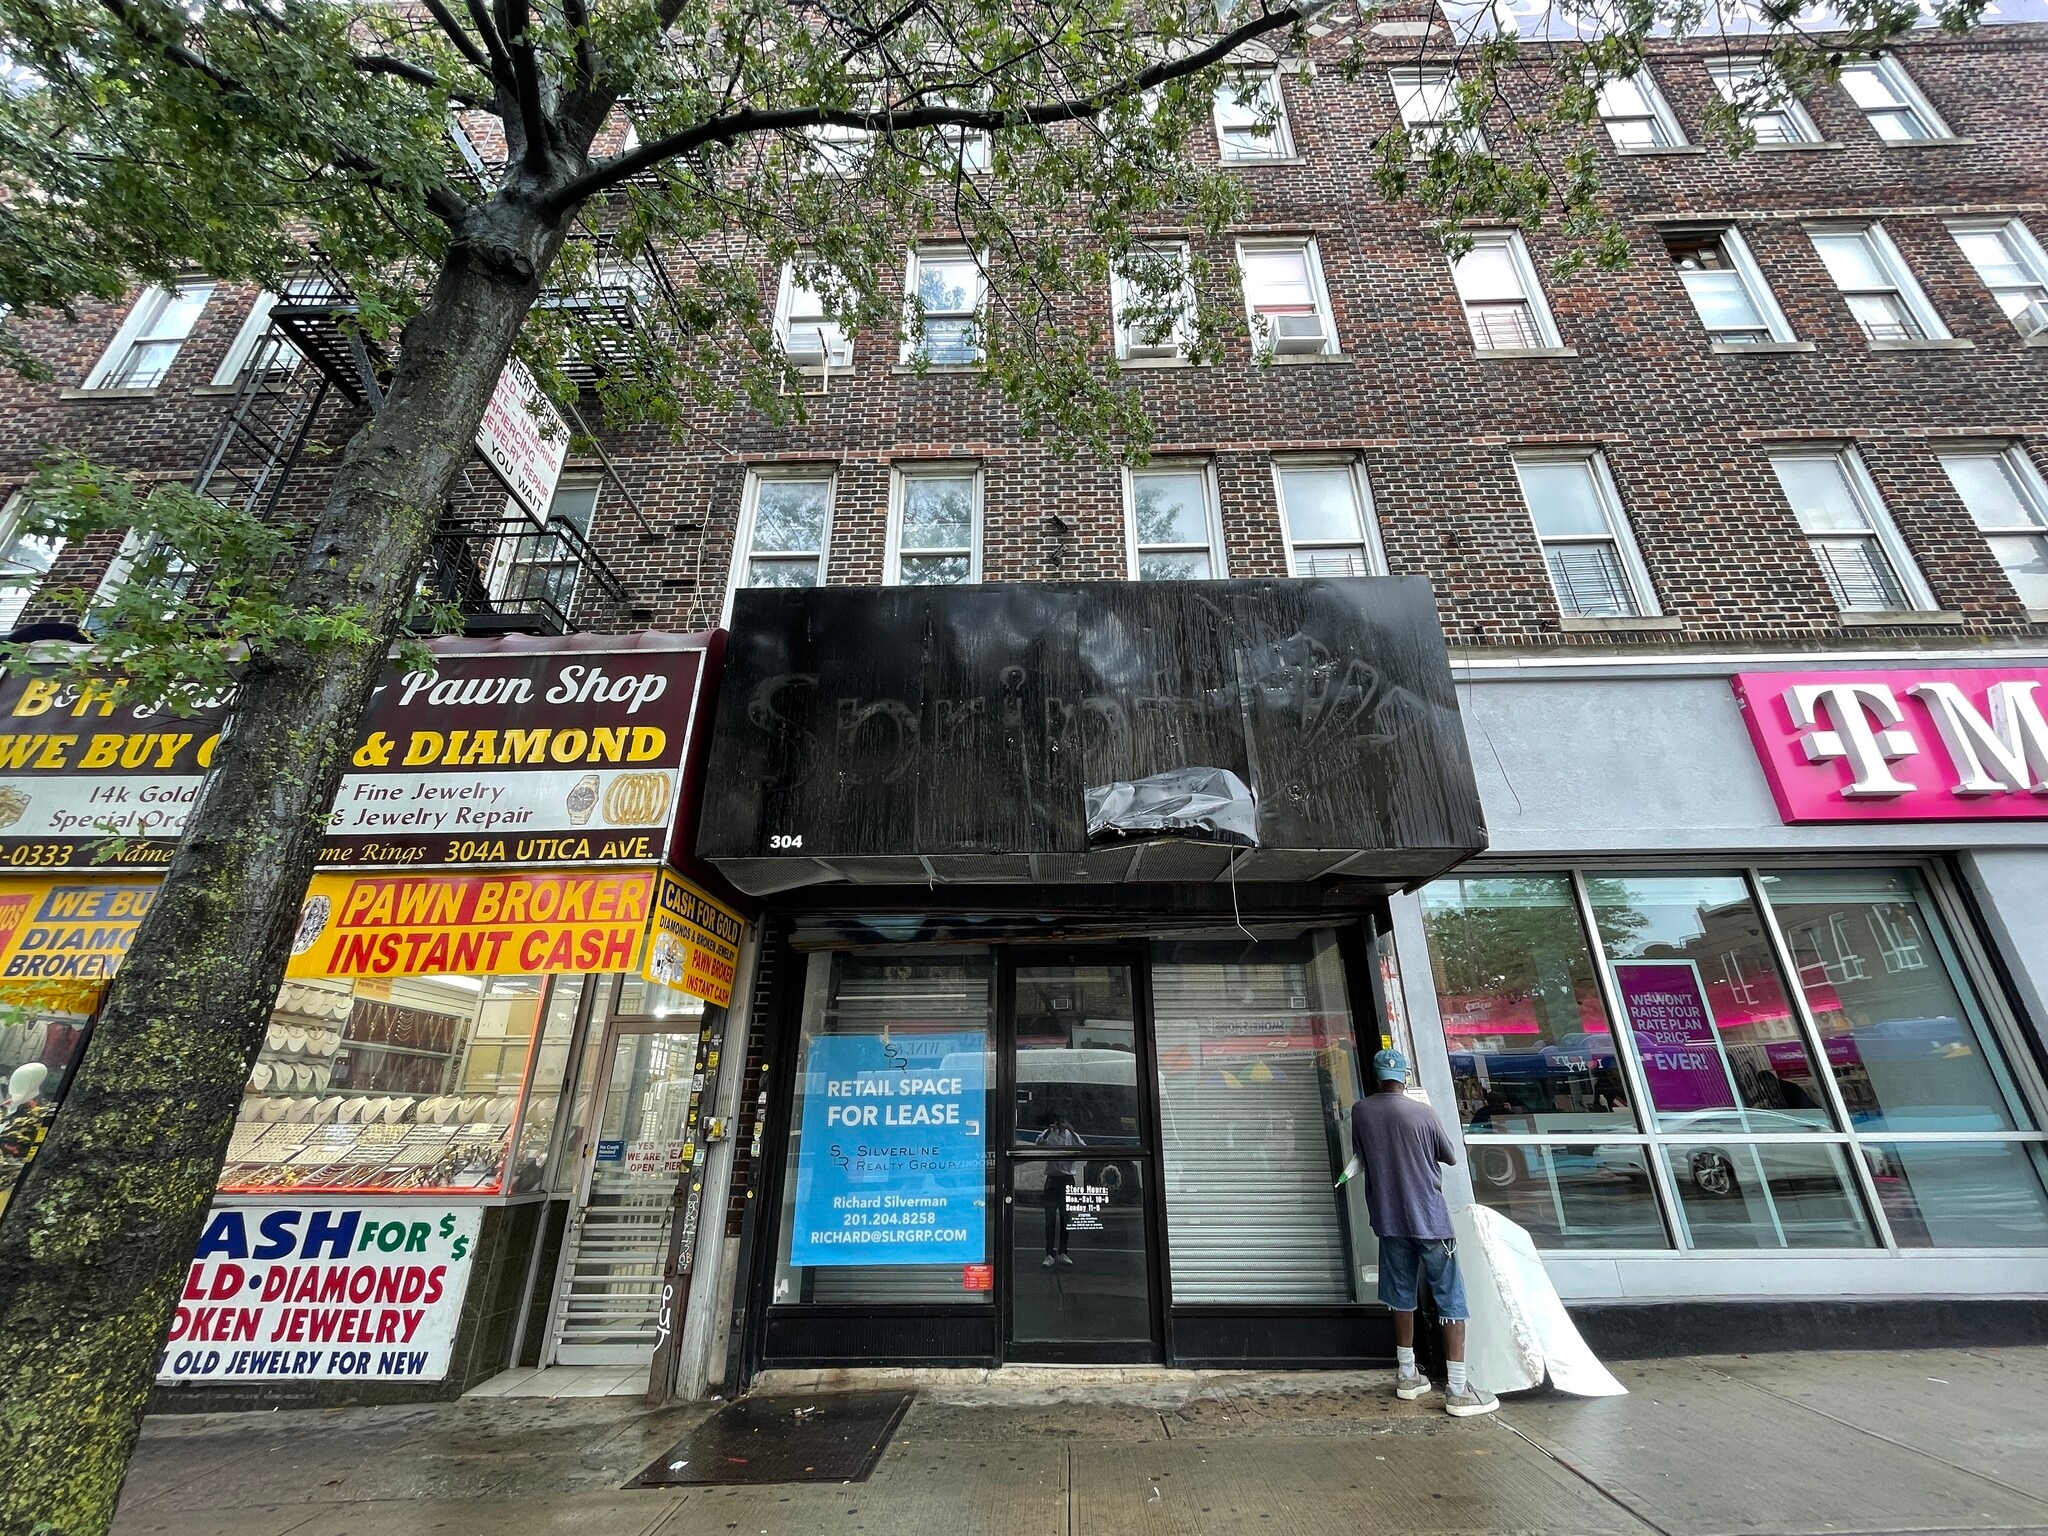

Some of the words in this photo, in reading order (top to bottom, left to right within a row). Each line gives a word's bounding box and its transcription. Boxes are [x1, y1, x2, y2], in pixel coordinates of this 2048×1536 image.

[482, 410, 522, 465] JEWELRY
[521, 460, 550, 502] REPAIR
[518, 416, 558, 474] NAMERING
[489, 440, 515, 477] YOU
[516, 474, 545, 515] WAIT
[398, 668, 535, 707] Pawn
[545, 664, 668, 714] Shop
[0, 733, 79, 769] WE
[77, 733, 194, 769] BUY
[352, 731, 396, 767] &
[401, 726, 667, 767] DIAMOND
[89, 786, 132, 804] 14k
[139, 785, 200, 804] Gold
[353, 783, 404, 801] Fine
[410, 782, 506, 804] Jewelry
[48, 809, 137, 833] Special
[330, 808, 346, 826] &
[352, 807, 449, 830] Jewelry
[455, 806, 534, 830] Repair
[0, 844, 74, 866] -0333
[359, 842, 428, 865] Rings
[444, 840, 506, 862] 304A
[516, 837, 590, 861] UTICA
[598, 836, 654, 860] AVE.
[769, 835, 804, 849] 304
[48, 892, 105, 918] WE
[342, 882, 467, 927] PAWN
[471, 877, 647, 924] BROKER
[665, 883, 695, 920] CASH
[697, 901, 715, 931] FOR
[716, 914, 738, 943] GOLD
[659, 914, 690, 940] DIAMONDS
[696, 932, 715, 952] BROKEN
[326, 930, 514, 974] INSTANT
[519, 927, 638, 972] CASH
[2, 954, 125, 977] BROKEN
[691, 948, 710, 974] PAWN
[710, 958, 734, 985] BROKER
[686, 974, 714, 997] INSTANT
[714, 985, 730, 1004] CASH
[1630, 994, 1652, 1006] WE
[1652, 994, 1693, 1006] WON'T
[1631, 1006, 1667, 1018] RAISE
[1666, 1006, 1701, 1018] YOUR
[1637, 1019, 1669, 1030] RATE
[1669, 1018, 1703, 1030] PLAN
[1655, 1031, 1691, 1043] PRICE
[1655, 1052, 1709, 1070] EVER!
[827, 1080, 895, 1097] RETAIL
[899, 1078, 962, 1096] SPACE
[827, 1105, 878, 1127] FOR
[885, 1103, 960, 1126] LEASE
[627, 1153, 641, 1161] WE
[642, 1152, 662, 1161] ARE
[638, 1142, 655, 1150] YES
[630, 1163, 655, 1172] OPEN
[857, 1160, 905, 1171] REALTY
[908, 1159, 957, 1171] GROUP
[833, 1196, 881, 1209] Richard
[884, 1195, 948, 1208] Silverman
[843, 1212, 936, 1226] 201.204.8258
[357, 1221, 432, 1252] FOR
[810, 1229, 967, 1244] RICHARD@SLRGRP.COM
[260, 1265, 448, 1304] DIAMONDS
[270, 1308, 426, 1344] JEWELRY
[173, 1350, 221, 1375] OLD
[224, 1350, 324, 1375] JEWELRY
[326, 1350, 371, 1375] FOR
[376, 1350, 429, 1375] NEW
